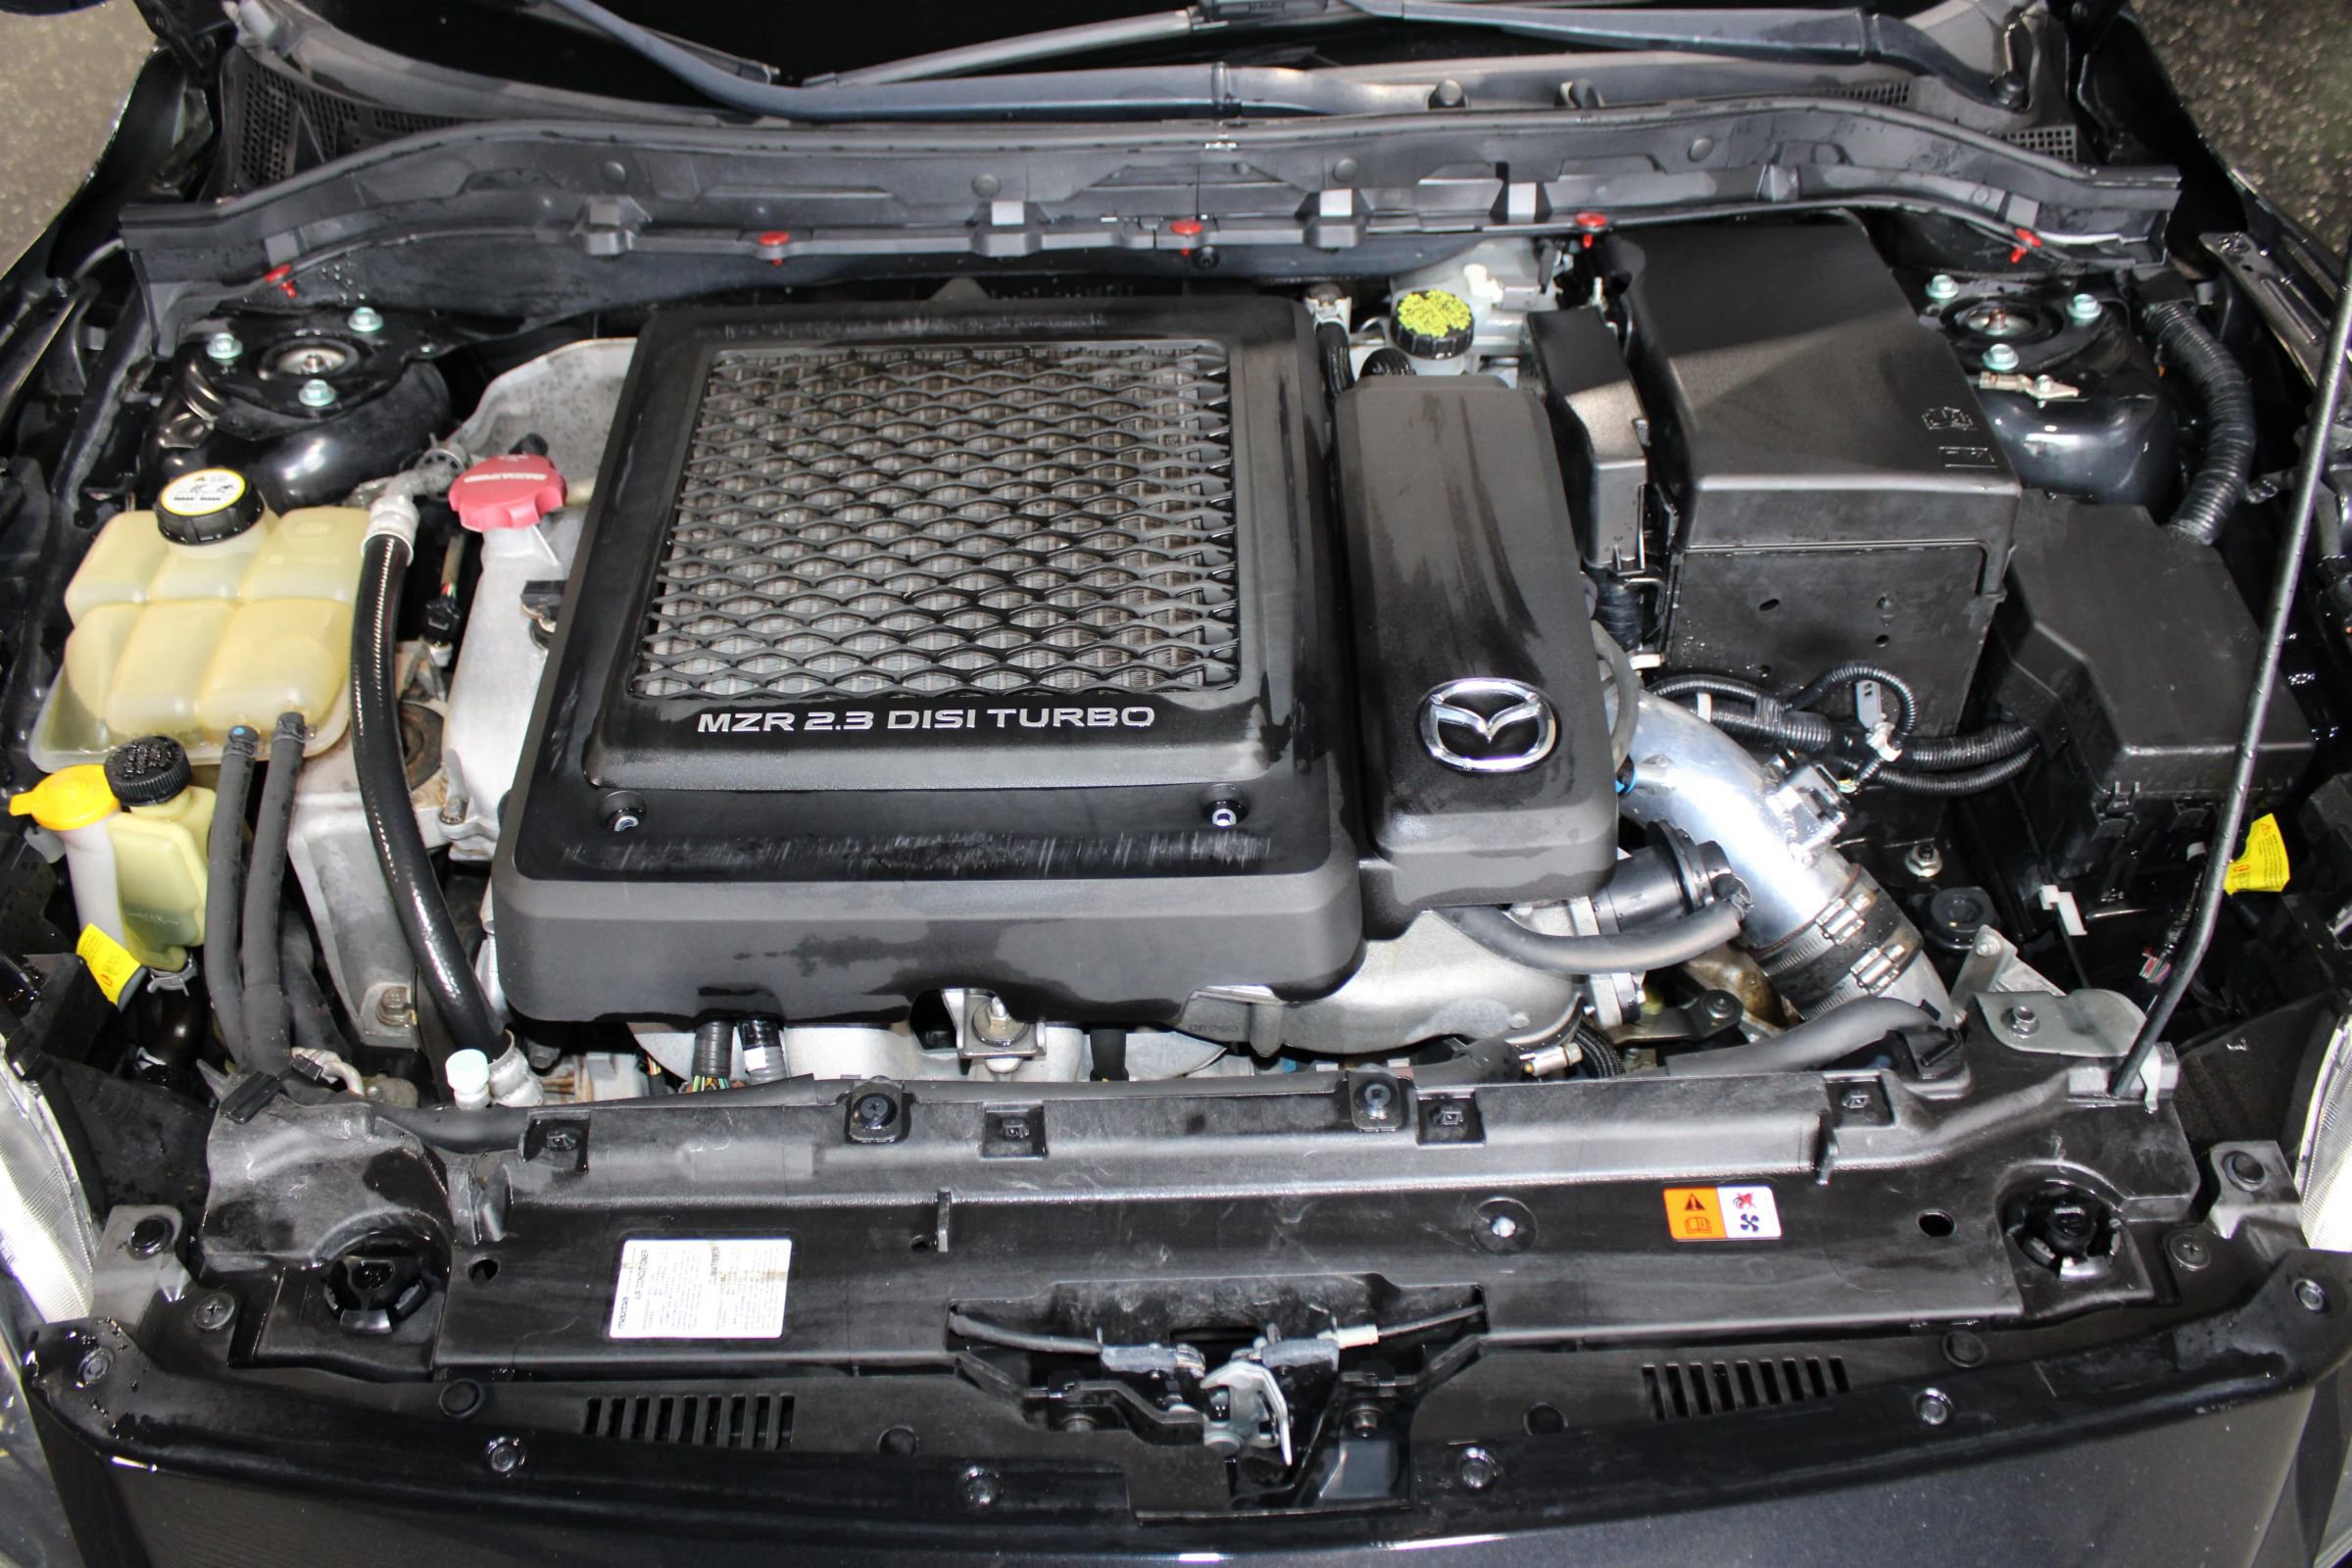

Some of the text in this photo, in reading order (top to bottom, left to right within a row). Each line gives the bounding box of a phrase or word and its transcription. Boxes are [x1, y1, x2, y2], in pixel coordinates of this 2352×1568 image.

[697, 706, 1155, 733] MZR 2.3 DISI TURBO
